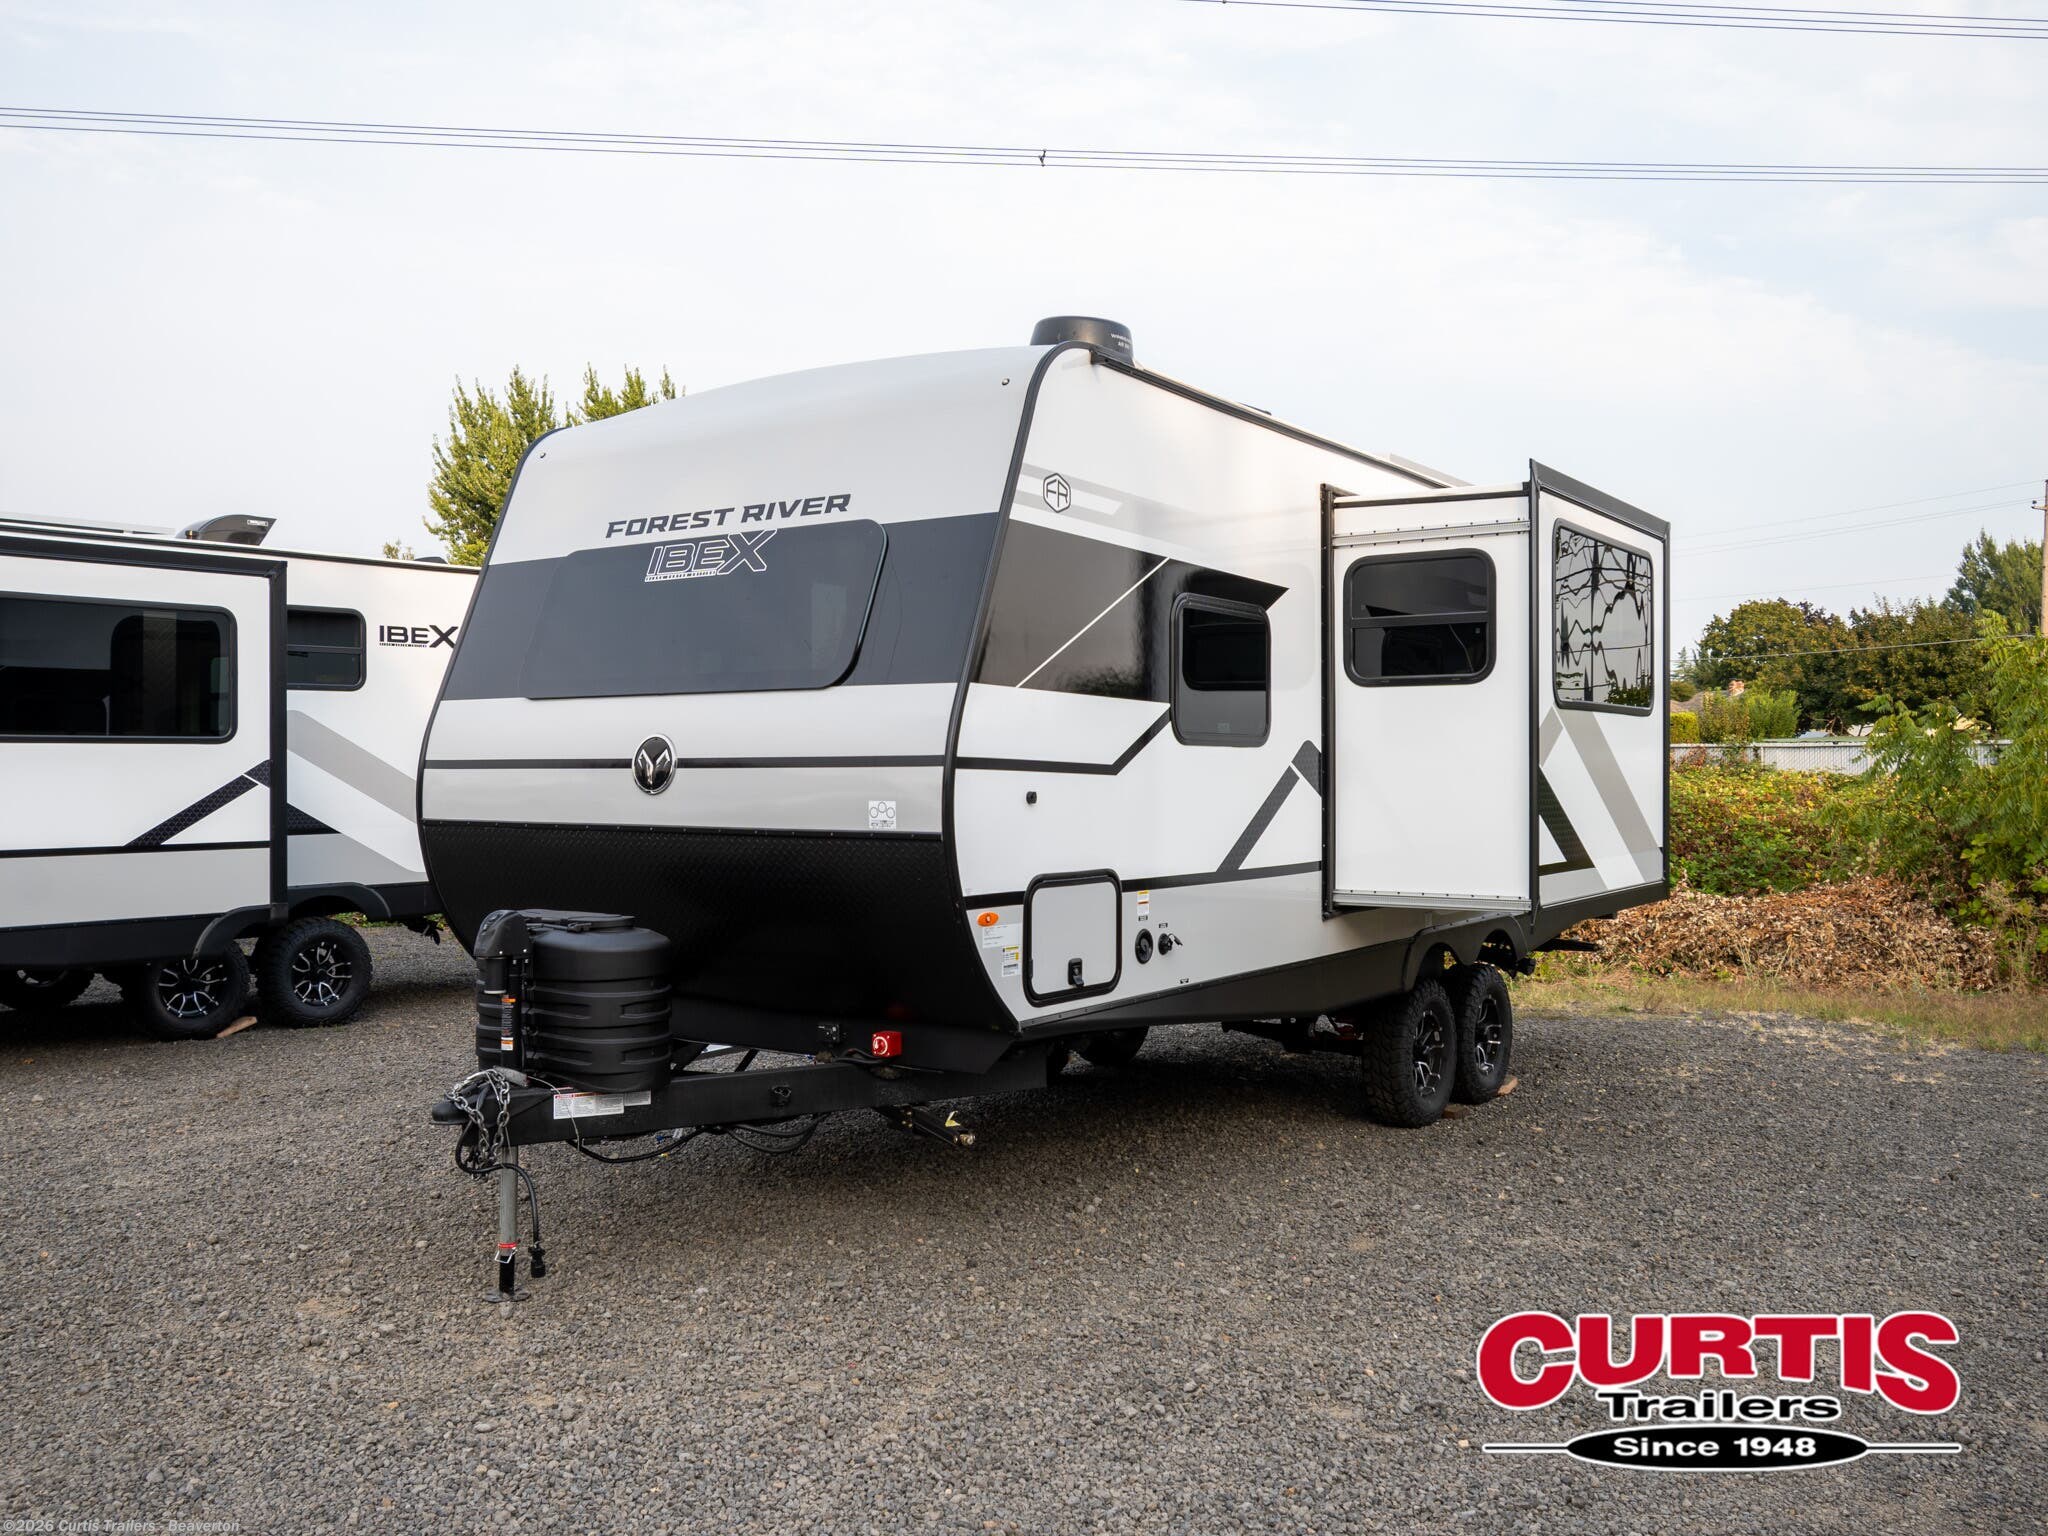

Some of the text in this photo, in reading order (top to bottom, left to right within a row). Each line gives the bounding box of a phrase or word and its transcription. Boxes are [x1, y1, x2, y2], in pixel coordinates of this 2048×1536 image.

[605, 493, 851, 538] FOREST RIVER
[646, 528, 777, 576] IBEX
[379, 624, 458, 648] IBEX
